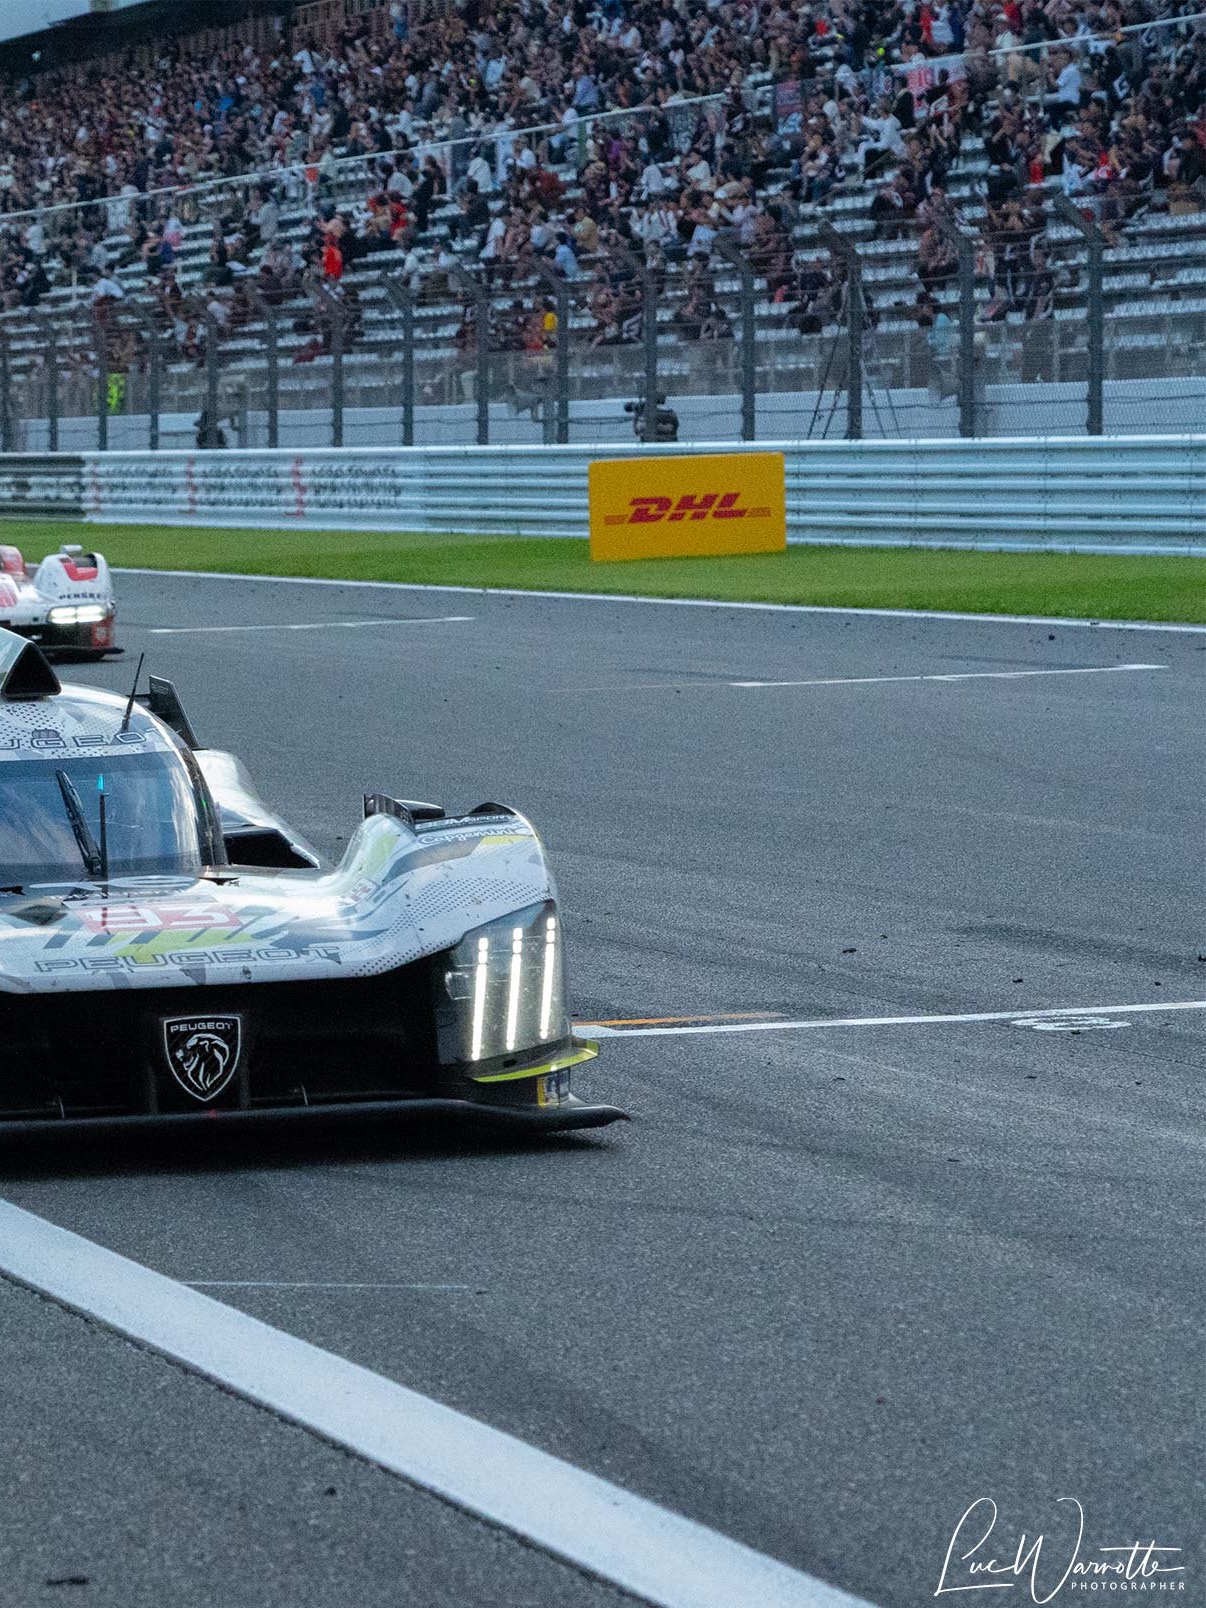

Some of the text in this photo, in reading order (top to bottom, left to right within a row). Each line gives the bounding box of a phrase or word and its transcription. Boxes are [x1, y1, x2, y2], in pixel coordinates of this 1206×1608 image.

[628, 493, 748, 524] DHL
[420, 827, 514, 846] Capgemini
[84, 902, 232, 930] 93
[35, 945, 342, 973] PEUGEOT
[170, 1022, 234, 1033] PEUGEOT
